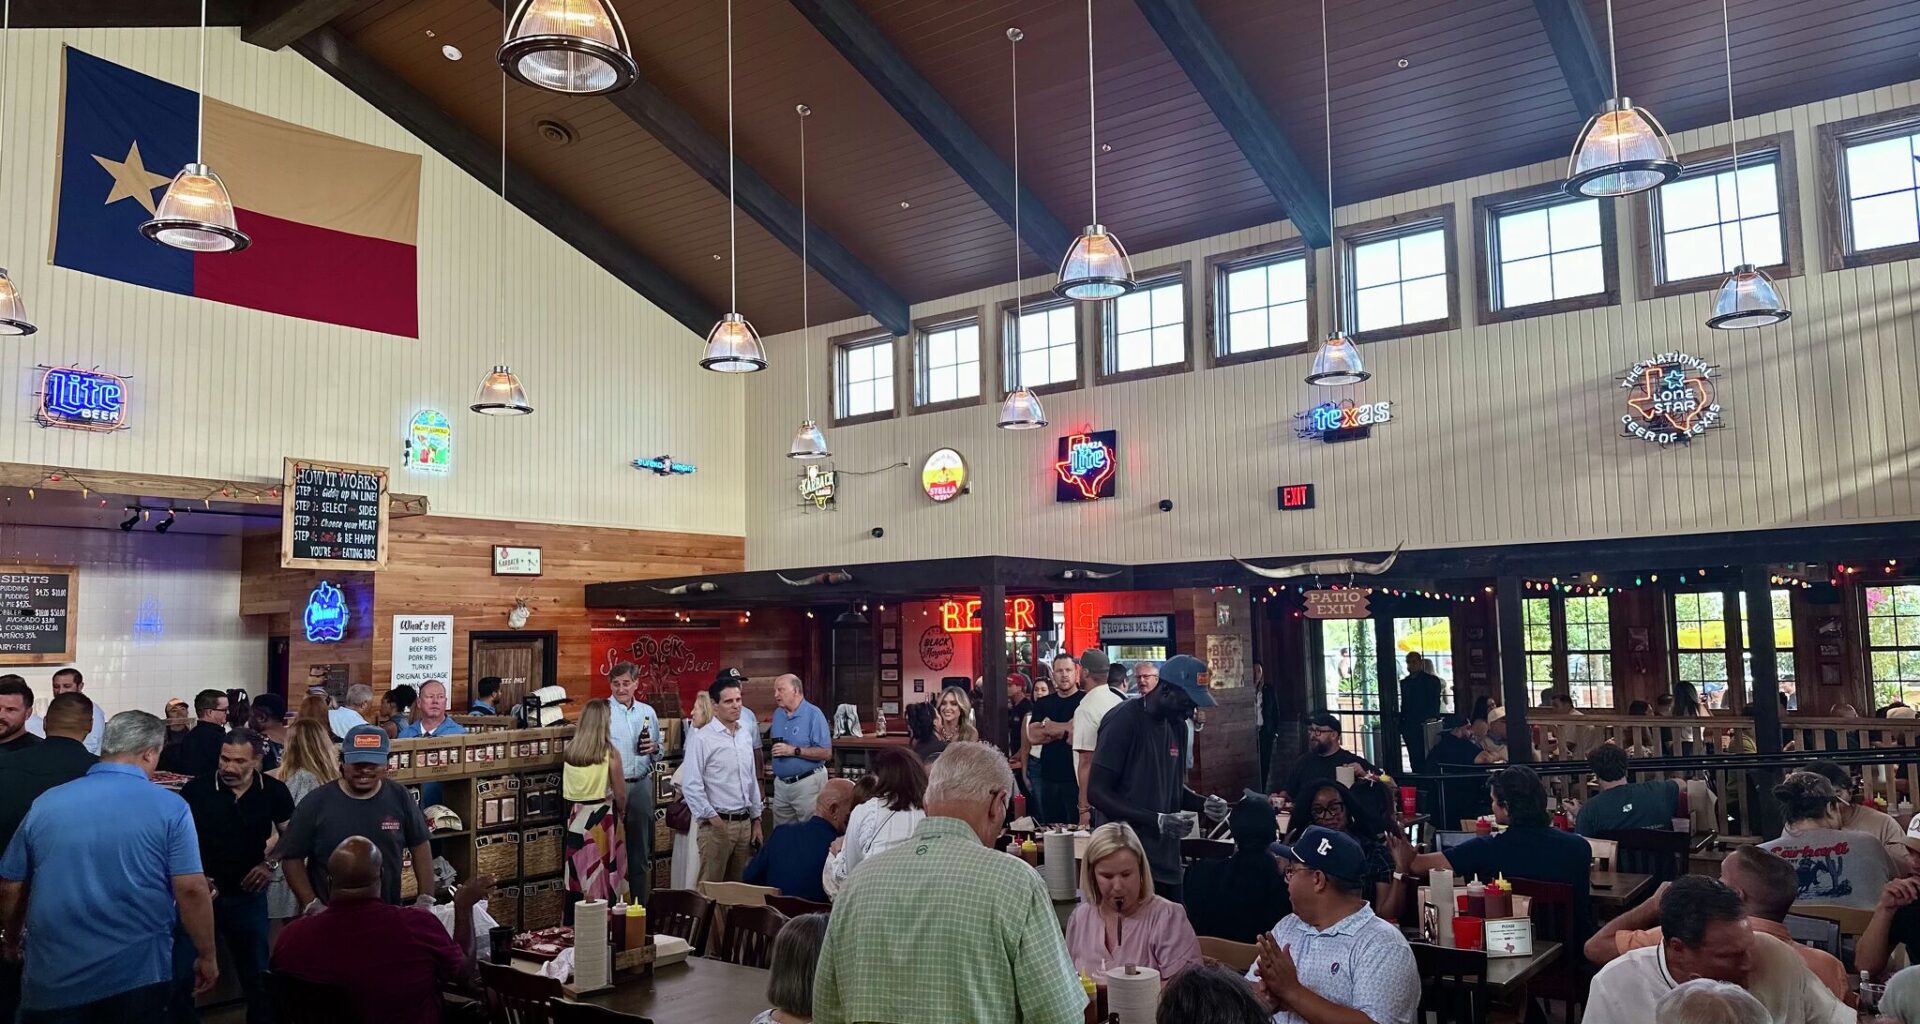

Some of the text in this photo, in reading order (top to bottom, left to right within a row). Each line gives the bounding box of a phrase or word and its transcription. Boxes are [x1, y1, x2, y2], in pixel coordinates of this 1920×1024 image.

[1621, 353, 1713, 388] THE NATIONAL
[49, 373, 121, 414] Lite
[1653, 389, 1694, 402] LONE
[81, 408, 119, 421] BEER
[1654, 400, 1696, 414] STAR
[1314, 401, 1390, 430] texas
[1621, 403, 1720, 443] BEER OF TEXAS
[1070, 449, 1105, 475] Lite
[296, 469, 378, 491] HOW IT WORKS
[296, 485, 312, 497] STEP
[350, 490, 359, 500] IN
[360, 491, 378, 502] LINE!
[1283, 486, 1307, 506] EXIT
[295, 500, 311, 512] STEP
[321, 502, 348, 514] SELECT
[358, 505, 377, 517] SIDES
[295, 515, 311, 527] STEP
[320, 518, 342, 529] Choose
[358, 520, 377, 531] MEAT
[294, 530, 310, 542] STEP
[336, 533, 343, 543] &
[344, 533, 353, 544] BE
[354, 533, 376, 545] HAPPY
[310, 546, 332, 558] YOU'RE
[342, 547, 363, 559] EATING
[363, 548, 376, 560] BBQ
[1310, 592, 1360, 603] PATIO
[1317, 604, 1356, 615] EXIT
[400, 619, 446, 631] What's left
[1101, 621, 1164, 634] FROZEN MEATS
[632, 638, 685, 660] BOCK
[924, 637, 949, 647] BLACK
[1211, 644, 1233, 657] BIG
[677, 652, 713, 673] Beer
[1211, 657, 1235, 670] RED
